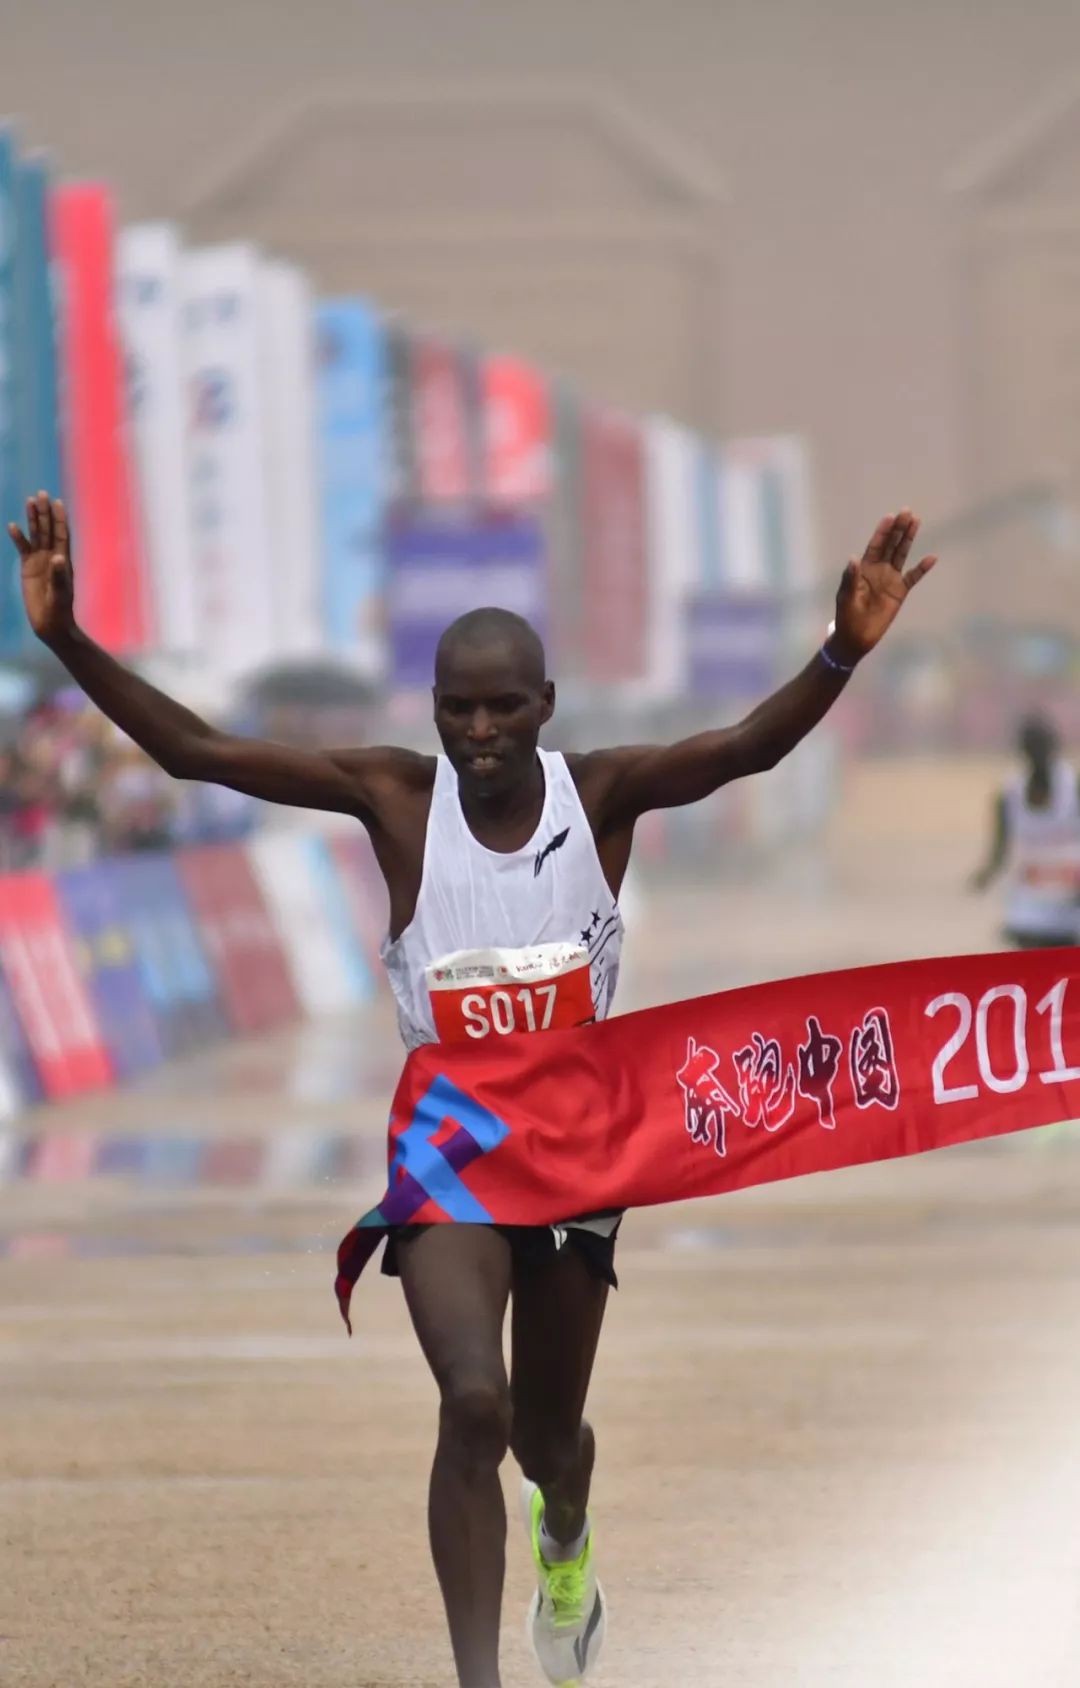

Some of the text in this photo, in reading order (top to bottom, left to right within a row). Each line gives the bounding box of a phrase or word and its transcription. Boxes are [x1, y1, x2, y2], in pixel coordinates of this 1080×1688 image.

[461, 984, 557, 1039] S017
[676, 1006, 900, 1157] 奔跑中国
